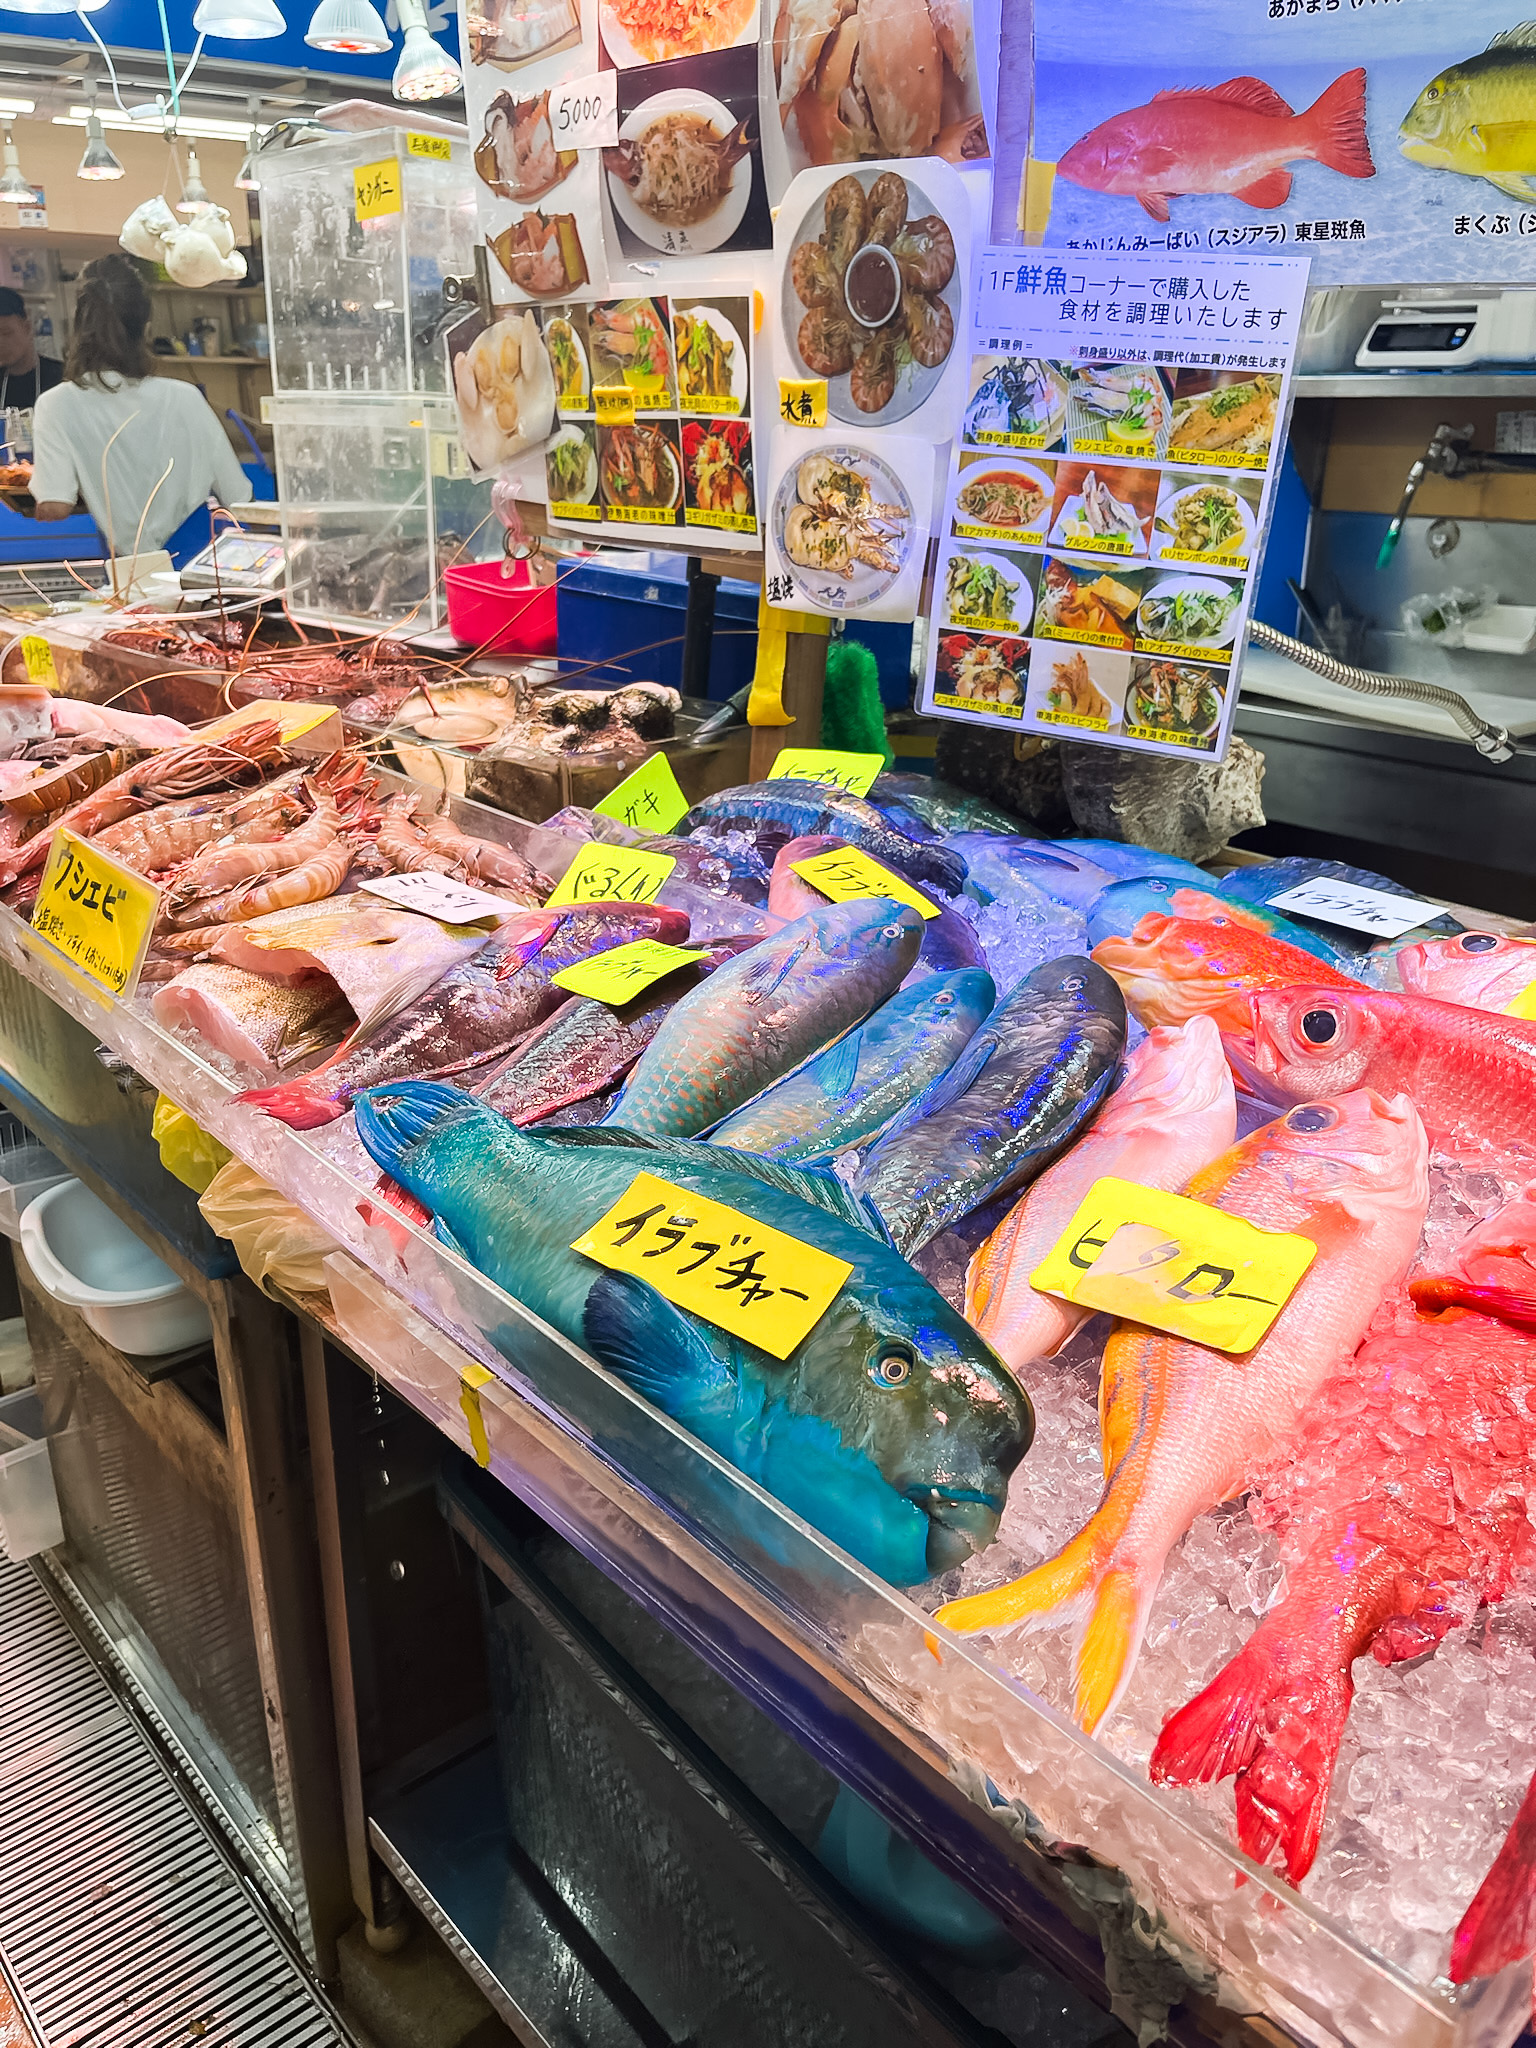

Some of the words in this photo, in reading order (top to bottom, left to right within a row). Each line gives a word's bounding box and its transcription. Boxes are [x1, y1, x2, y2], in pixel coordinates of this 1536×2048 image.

[1208, 223, 1287, 248] (スジアラ)
[1295, 219, 1366, 242] 東星斑魚
[1454, 214, 1511, 235] まくぶ
[990, 264, 1251, 301] 1F鮮魚コーナーで購入した
[1058, 298, 1288, 331] 食材を調理いたします
[781, 390, 817, 426] 水煮
[976, 431, 1046, 448] 刺身の盛り合わせ
[1073, 440, 1156, 457] ウシエビの塩焼き
[956, 524, 1043, 544] 魚(アカマチ)のあんかけ
[1065, 536, 1134, 554] グルクンの唐揚げ
[1160, 549, 1248, 568] ハリセンボンの唐揚げ
[950, 615, 1019, 632] 夜光貝のバター炒め
[1044, 627, 1124, 646] 魚(ミーバイ)の煮付け
[1036, 710, 1109, 731] 車海老のエビフライ
[1127, 726, 1209, 748] 伊勢海老の味噌汁
[54, 840, 127, 923] ウシエビ
[611, 1203, 810, 1307] イラブチャー
